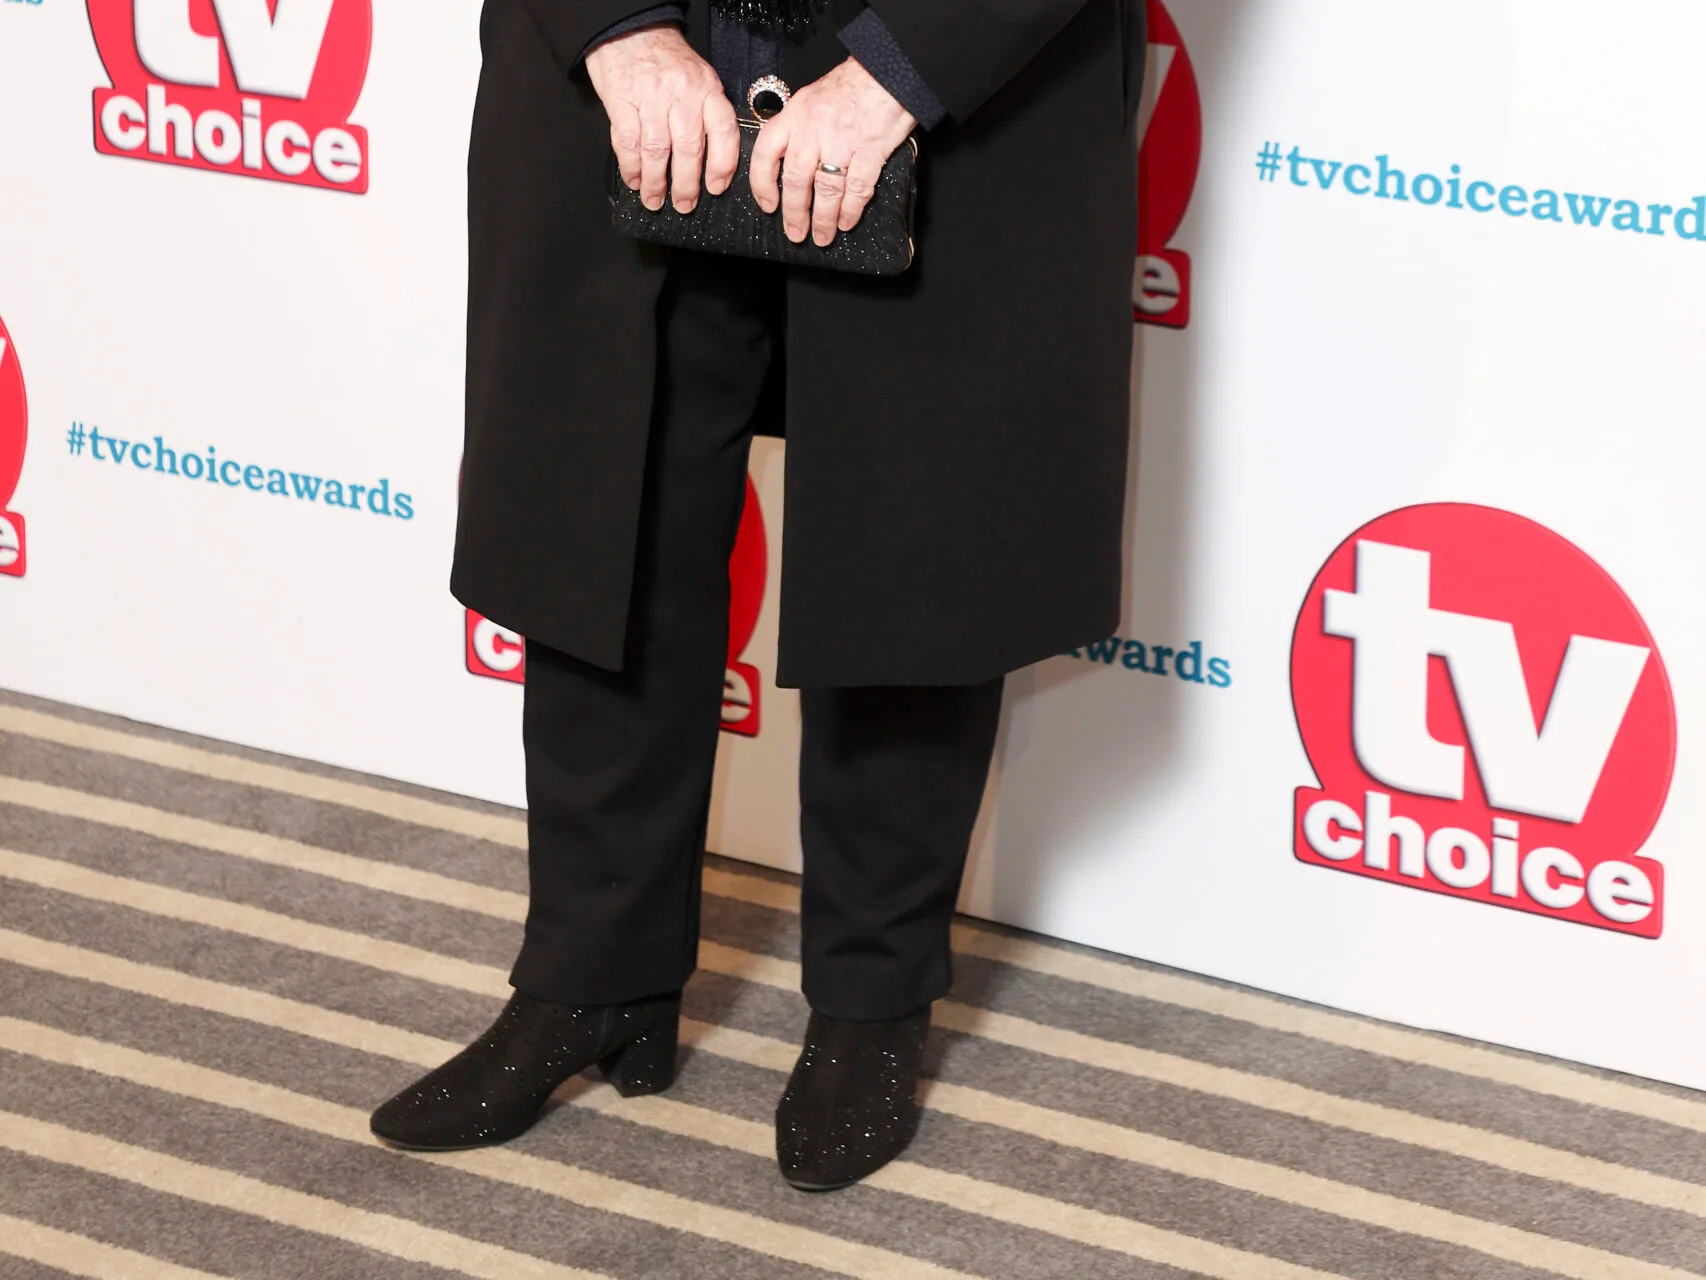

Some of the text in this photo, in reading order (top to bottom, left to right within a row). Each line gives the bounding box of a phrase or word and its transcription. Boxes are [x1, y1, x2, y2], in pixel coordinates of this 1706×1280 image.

[100, 83, 363, 184] choice
[66, 420, 415, 520] #tvchoiceawards
[1063, 635, 1232, 689] wards
[1322, 538, 1652, 825] tv
[1302, 790, 1655, 924] choice
